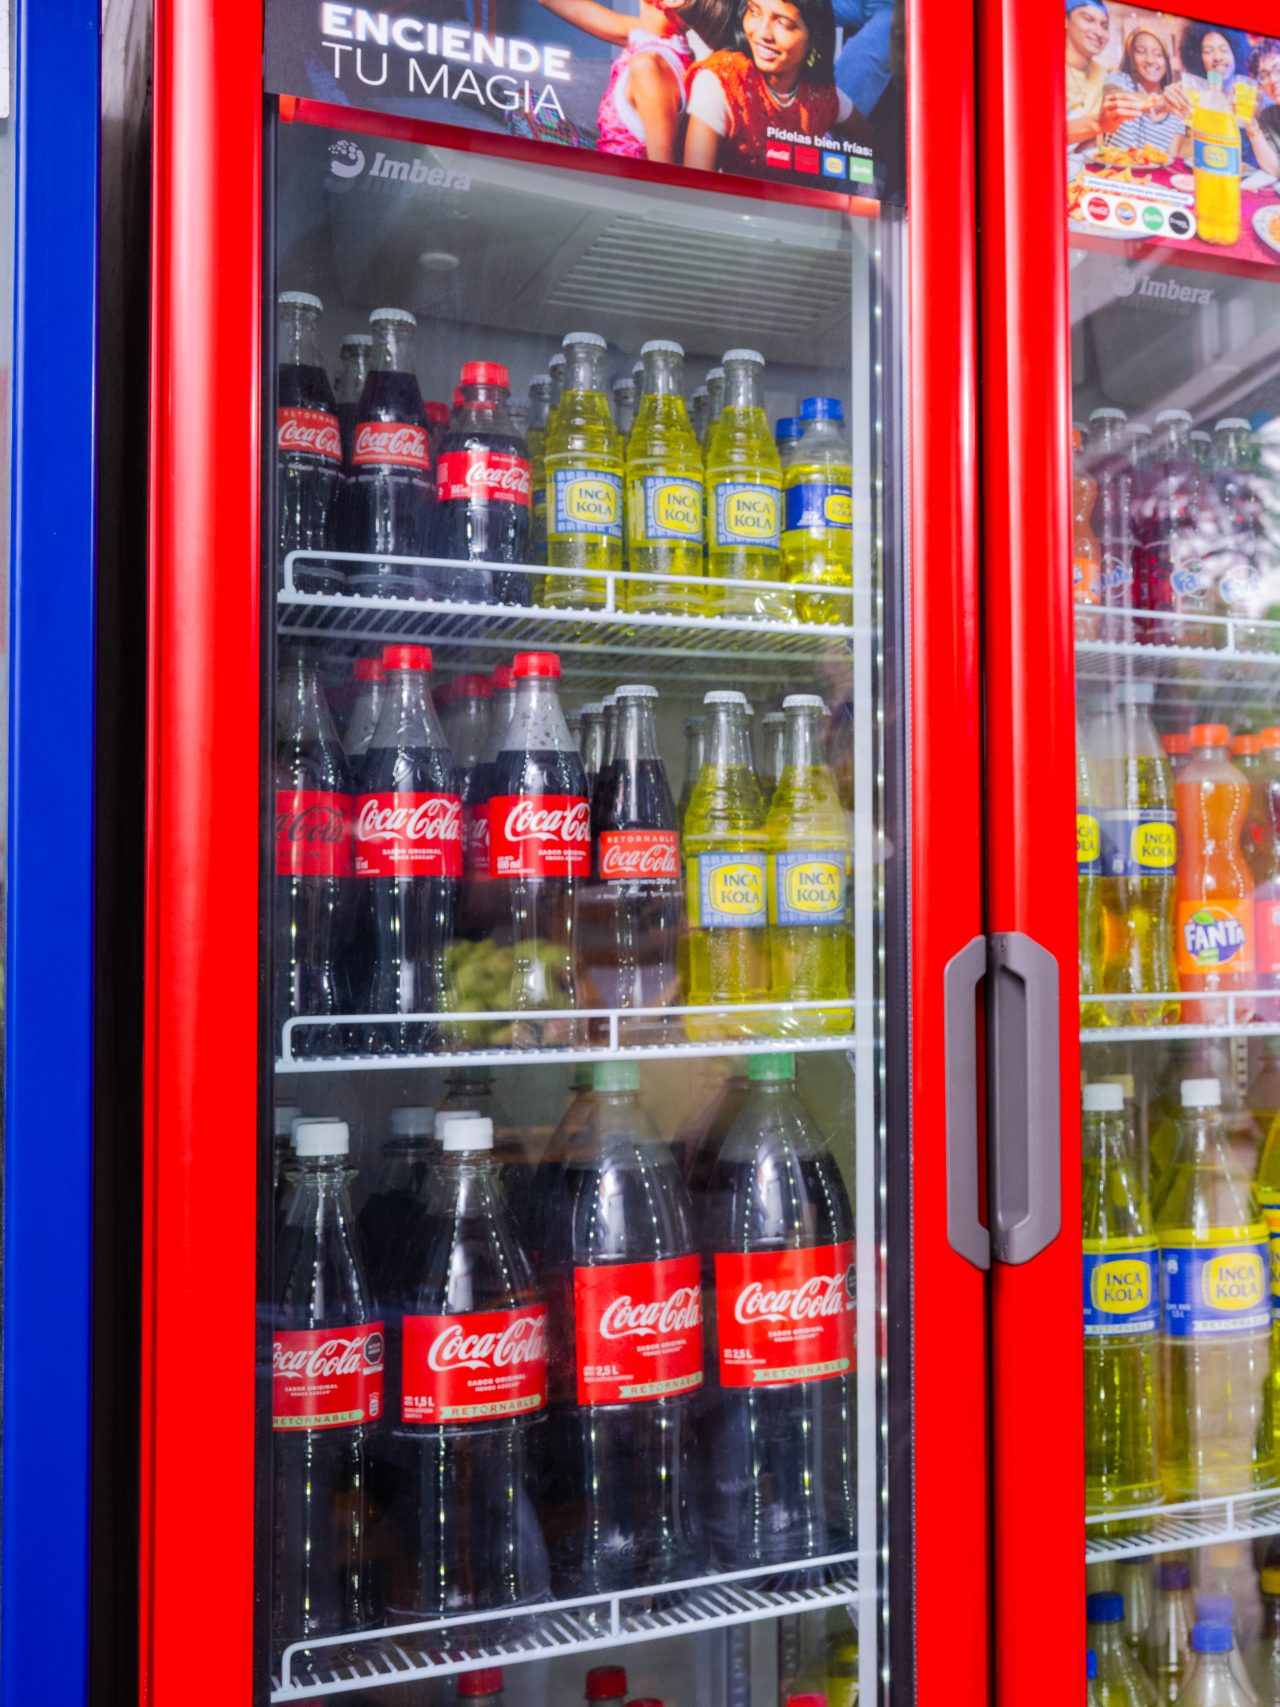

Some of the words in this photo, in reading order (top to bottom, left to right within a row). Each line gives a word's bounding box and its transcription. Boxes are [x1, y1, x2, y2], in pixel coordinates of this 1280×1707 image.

[322, 3, 572, 81] ENCIENDE
[322, 41, 388, 86] TU
[408, 58, 566, 120] MAGIA
[766, 126, 812, 145] Pídelas
[814, 135, 841, 151] bien
[843, 141, 873, 157] frías:
[369, 152, 472, 192] Imbera
[1138, 274, 1211, 305] Imbera
[356, 426, 426, 457] Coca-Cola
[465, 461, 530, 494] Coca-Cola
[578, 488, 611, 502] INCA
[666, 493, 698, 509] INCA
[576, 501, 613, 516] KOLA
[736, 499, 771, 514] INCA
[664, 509, 698, 525] KOLA
[734, 515, 772, 530] KOLA
[358, 798, 461, 841] Coca-Cola
[504, 800, 591, 842] Coca-Col
[603, 844, 676, 874] Coca-Cola
[723, 874, 759, 886] INCA
[799, 872, 835, 885] INCA
[721, 890, 760, 904] KOLA
[797, 888, 836, 902] KOLA
[1184, 920, 1246, 951] FANTA
[1106, 1272, 1142, 1287] INCA
[1218, 1265, 1256, 1281] INCA
[734, 1273, 845, 1325] Coca-Cola
[1104, 1288, 1144, 1302] KOLA
[1216, 1282, 1258, 1299] KOLA
[600, 1285, 700, 1339] Coca-Cola
[427, 1314, 547, 1372] Coca-Cola
[273, 1336, 366, 1378] oca-Cola
[763, 1361, 843, 1378] RETORNABLE
[452, 1396, 535, 1416] RETORNABLE
